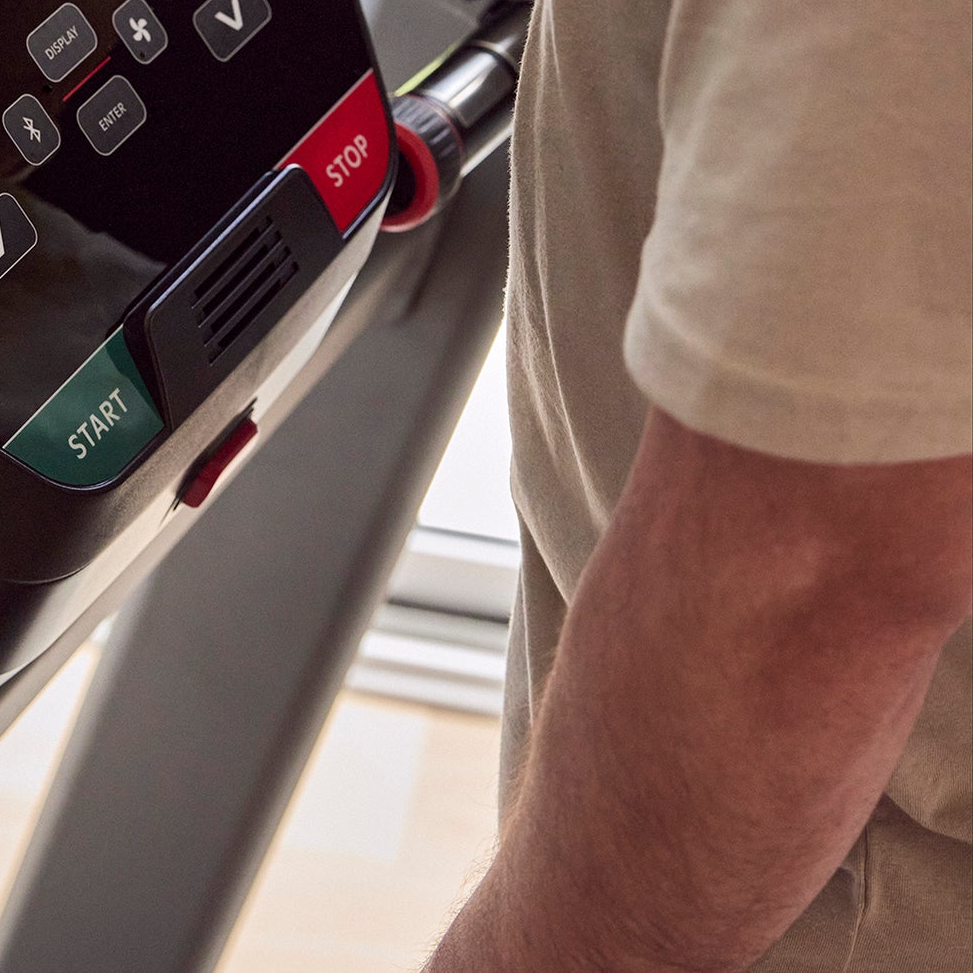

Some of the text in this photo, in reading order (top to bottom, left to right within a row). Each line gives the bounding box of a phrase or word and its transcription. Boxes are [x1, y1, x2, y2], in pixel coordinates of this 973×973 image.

[44, 26, 80, 61] DISPLAY
[98, 103, 127, 132] ENTER
[325, 135, 369, 188] STOP
[67, 388, 129, 459] START
